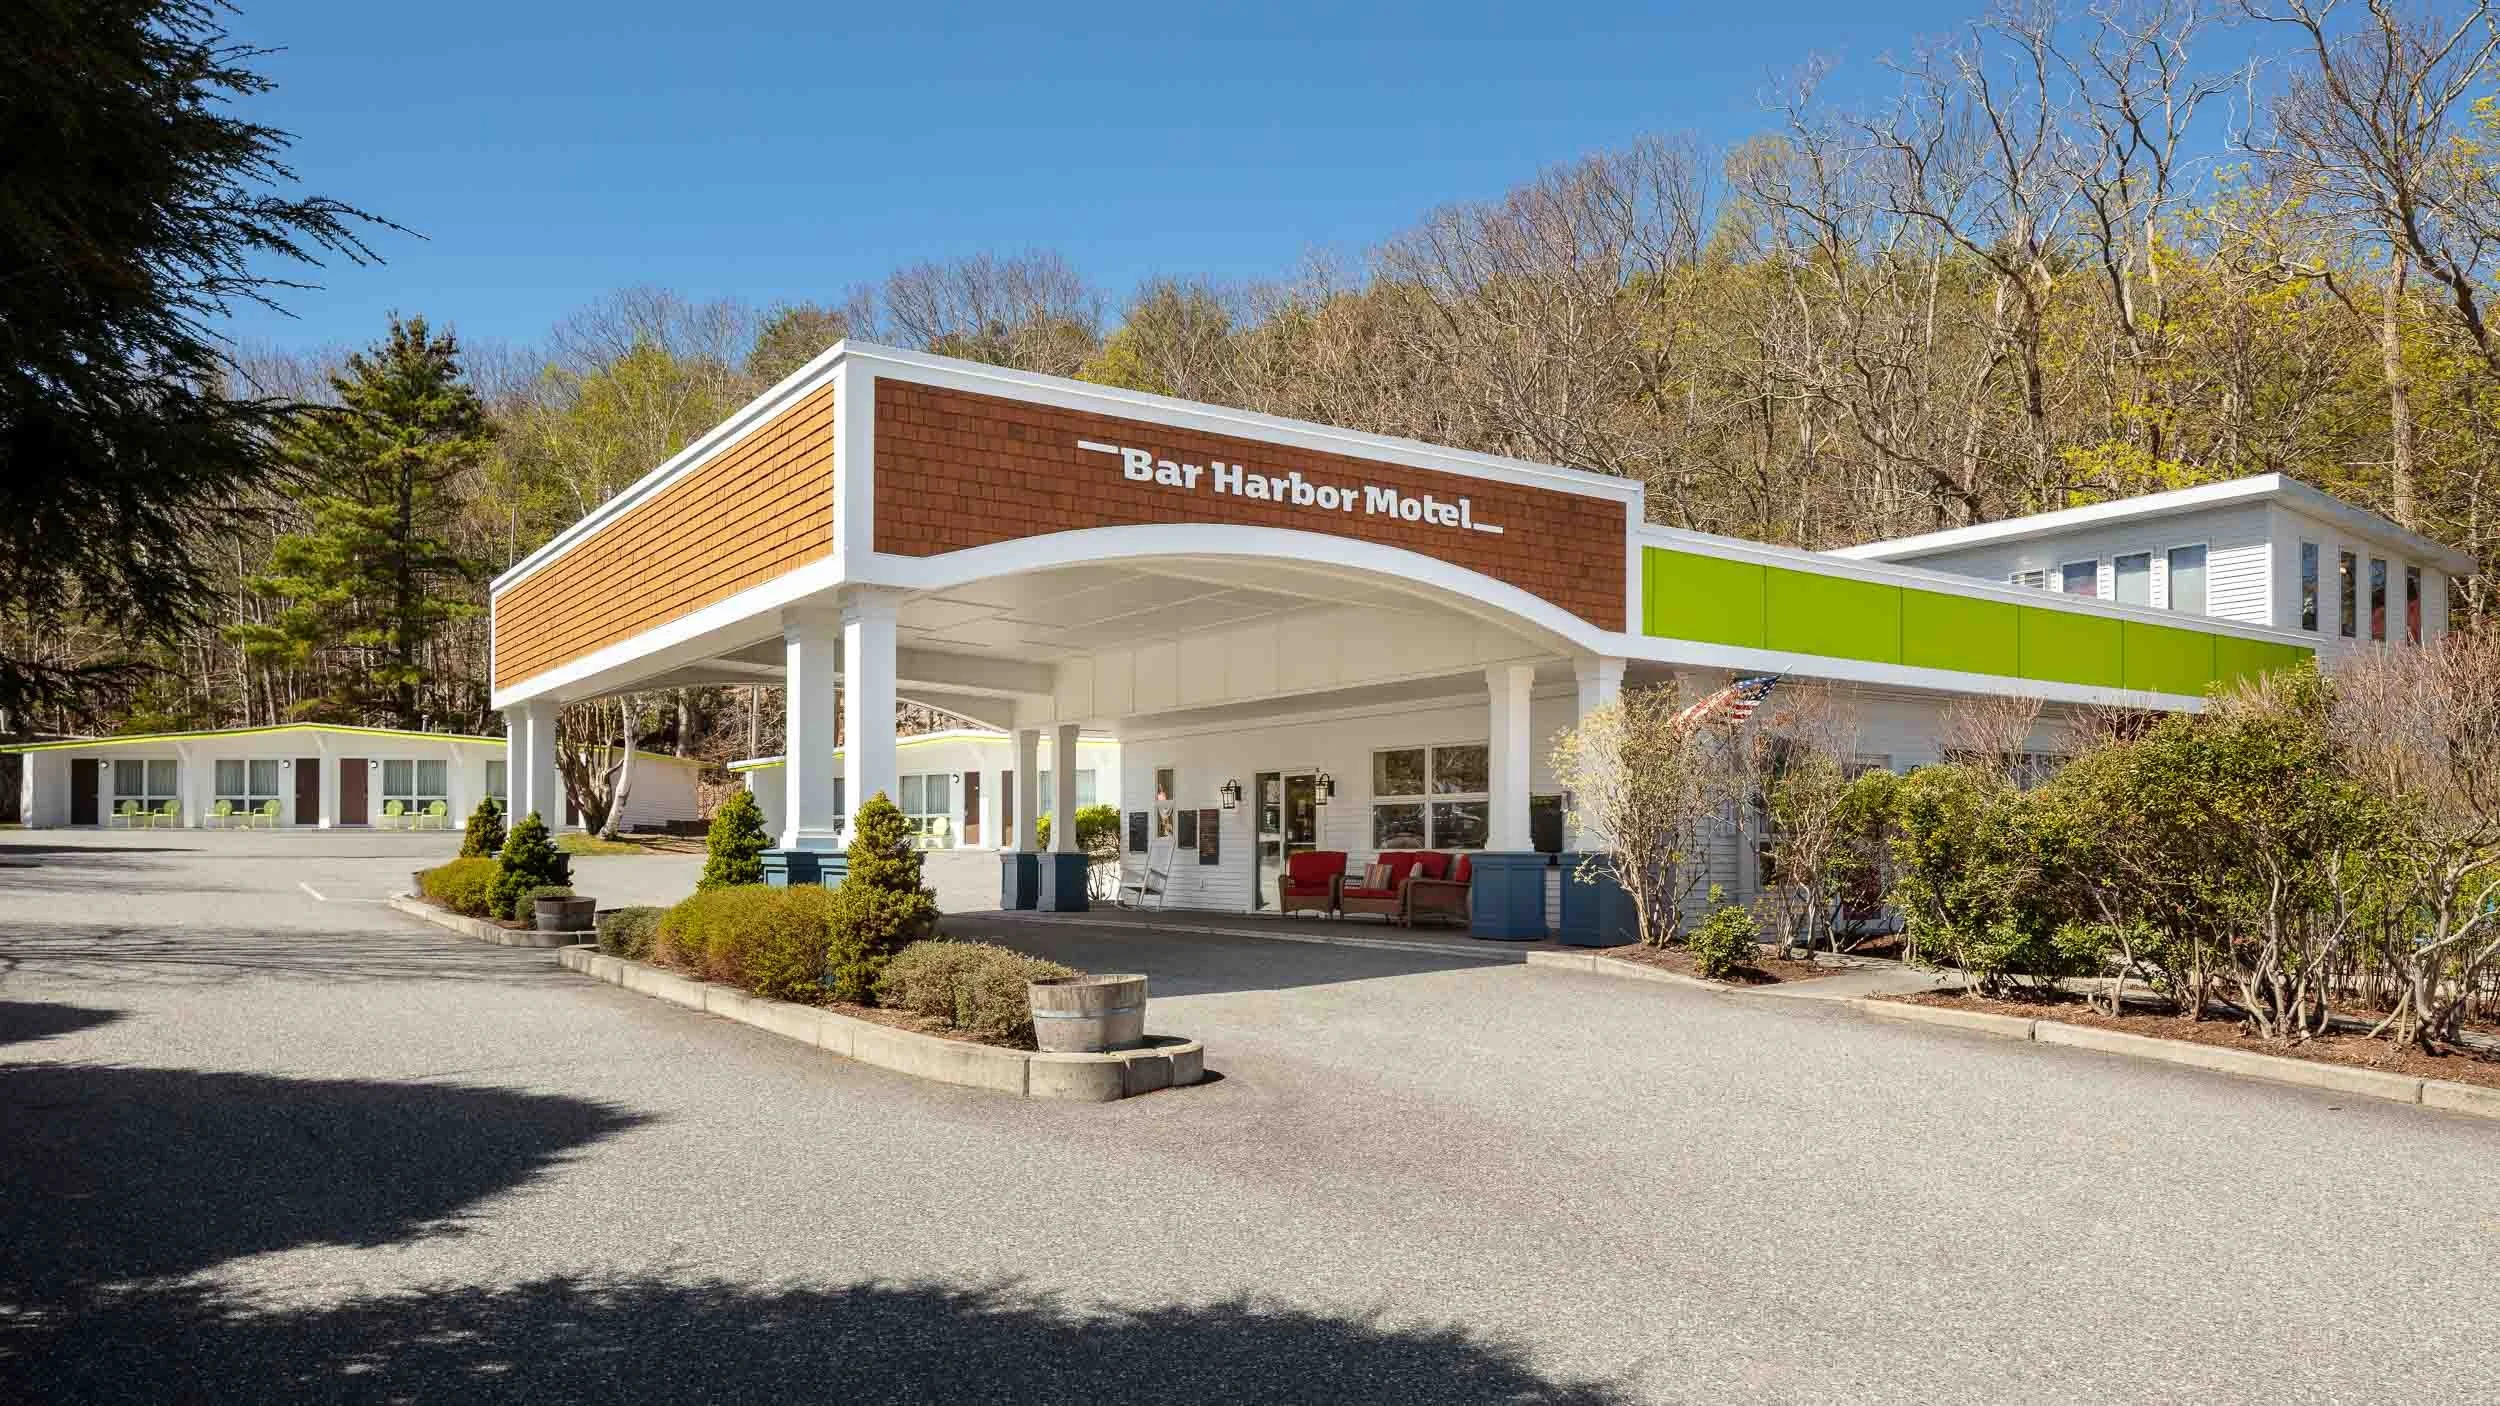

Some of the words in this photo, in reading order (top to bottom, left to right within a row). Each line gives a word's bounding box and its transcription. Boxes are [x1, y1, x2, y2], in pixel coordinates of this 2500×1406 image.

[1120, 447, 1203, 489] Bar
[1211, 461, 1359, 512] Harbor
[1365, 485, 1472, 529] Motel
